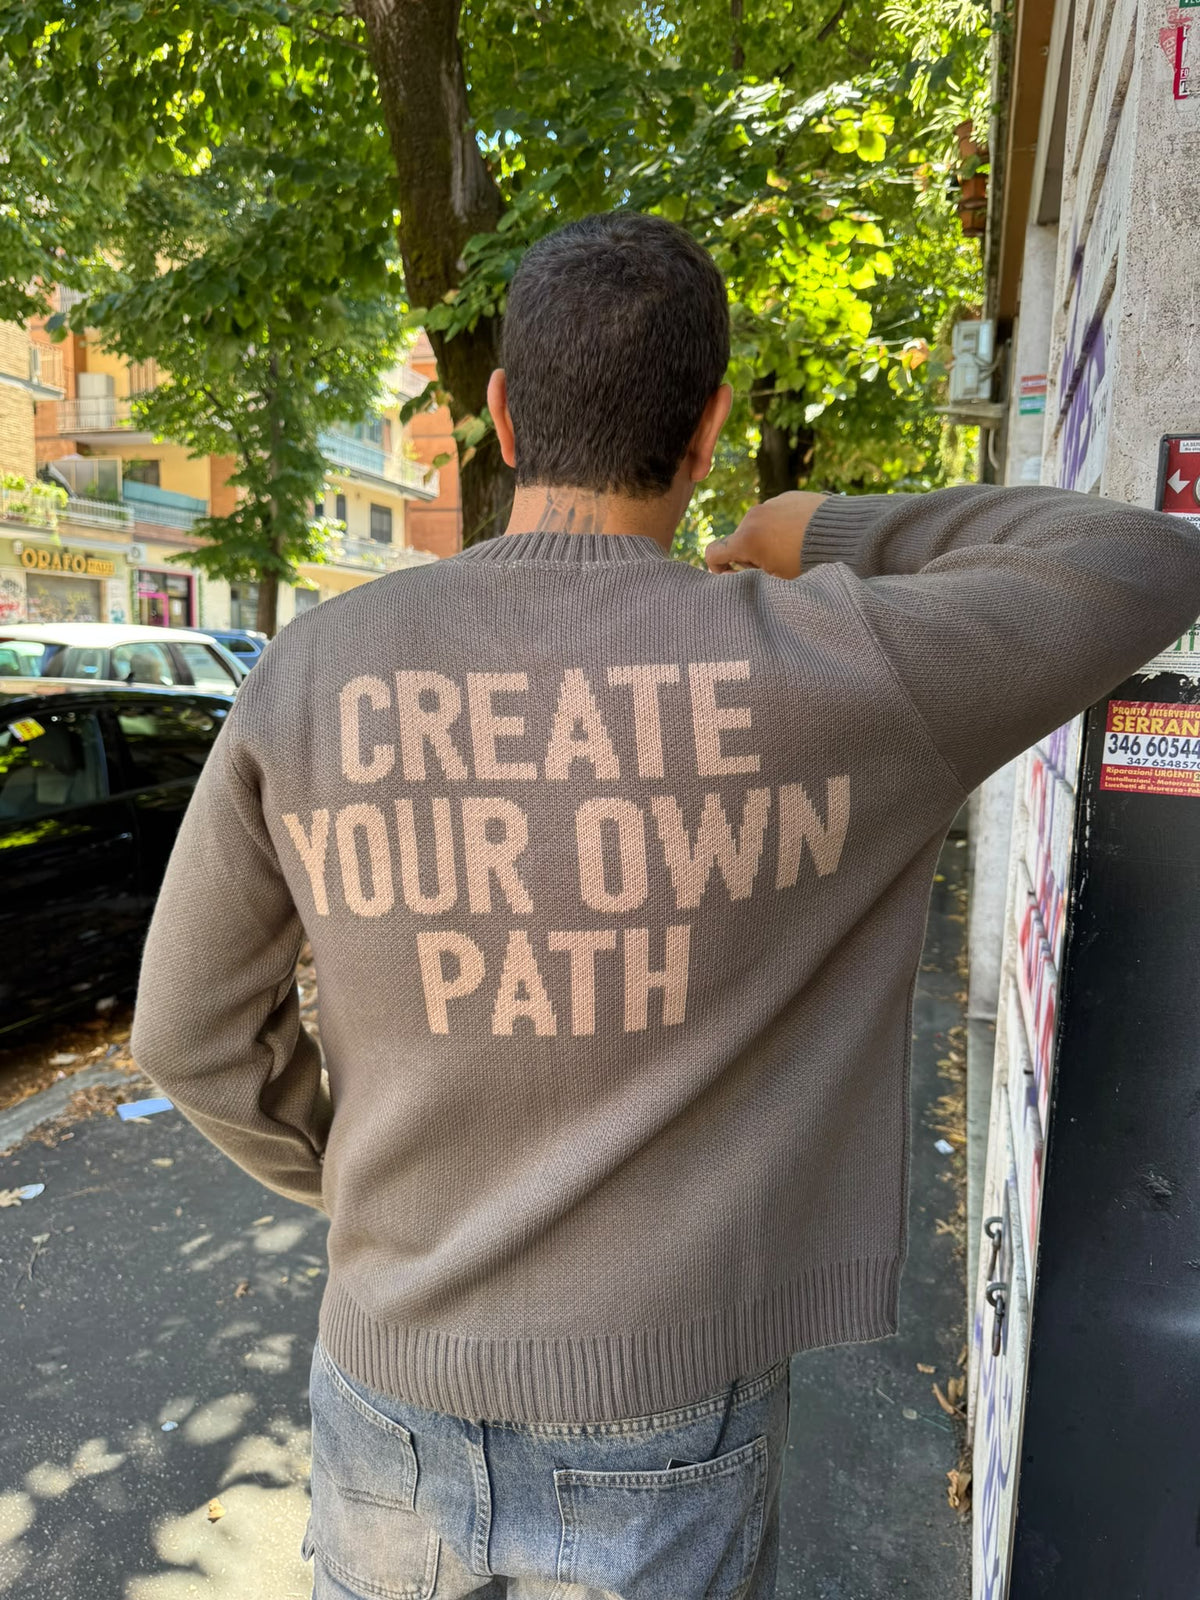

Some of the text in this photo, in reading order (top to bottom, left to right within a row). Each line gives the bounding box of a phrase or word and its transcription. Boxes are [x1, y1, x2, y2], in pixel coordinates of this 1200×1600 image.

[1112, 706, 1147, 716] PRONTO
[339, 660, 761, 783] CREATE
[1108, 733, 1141, 756] 346
[1127, 757, 1149, 766] 347
[1106, 766, 1153, 777] Riparazioni
[1154, 769, 1193, 779] URGENTI
[1104, 781, 1137, 789] Lucchetti
[1147, 784, 1184, 793] sicurezza
[282, 775, 852, 917] YOUR OWN
[416, 924, 691, 1036] PATH
